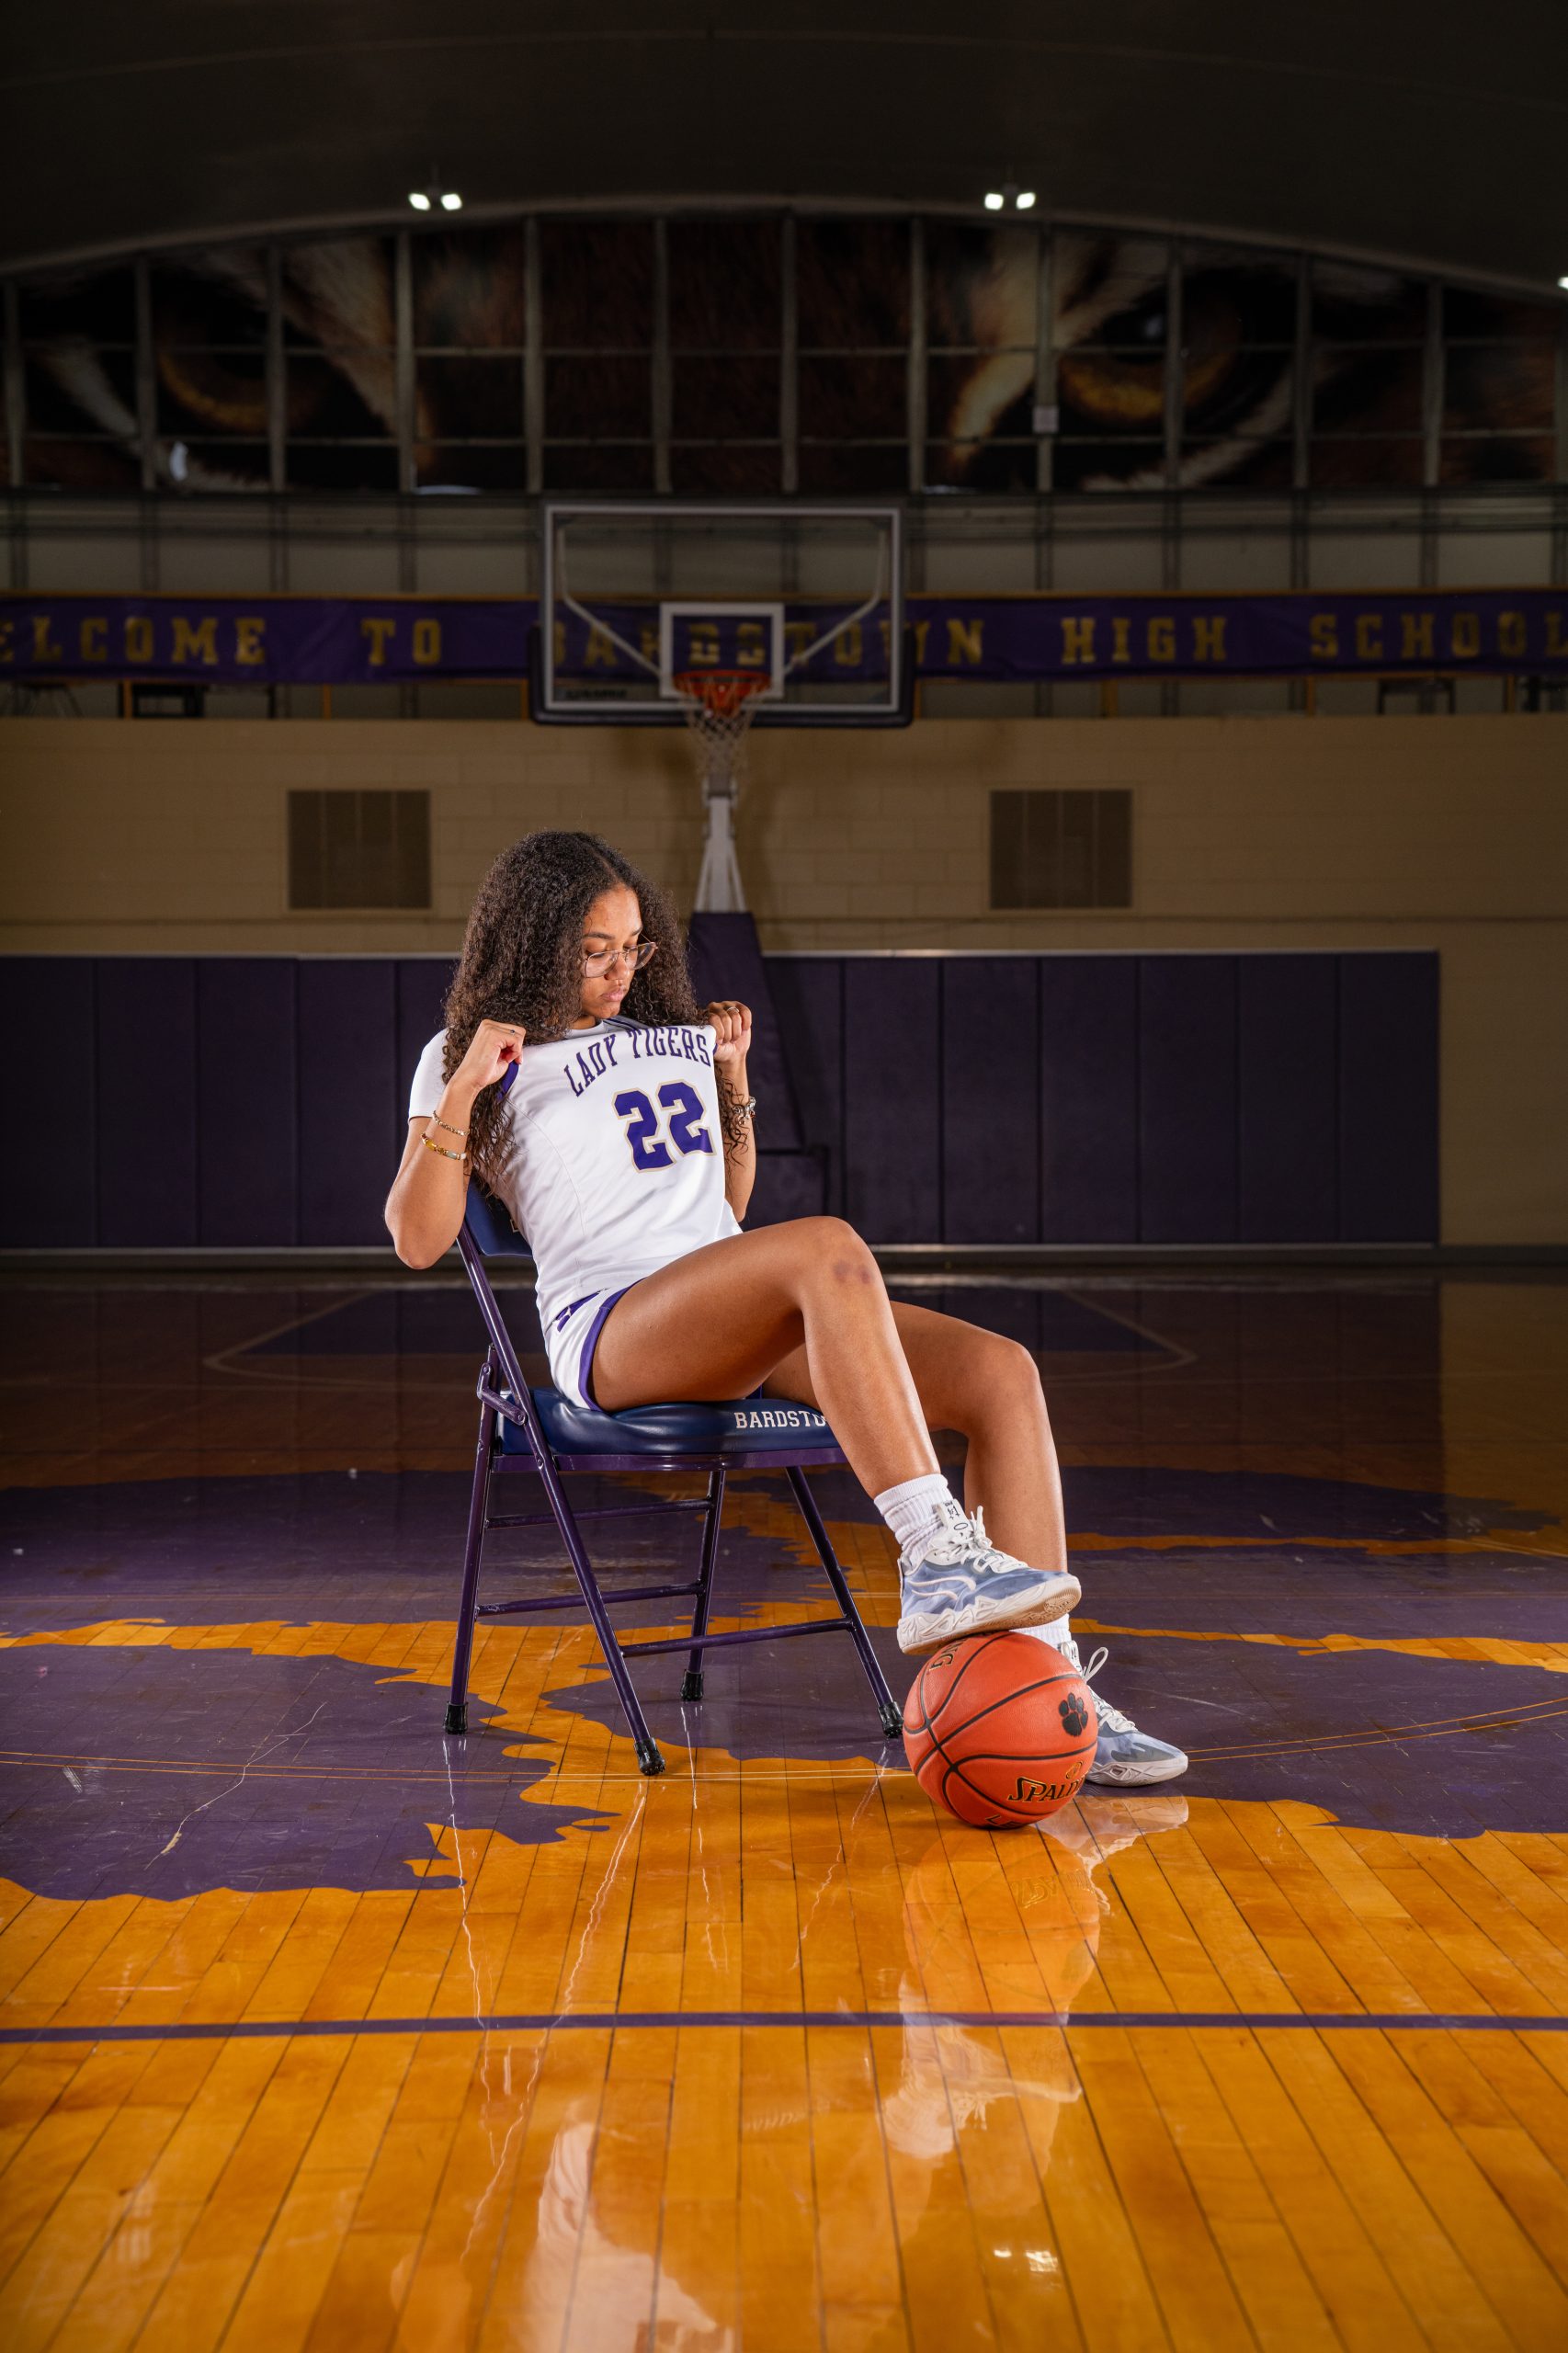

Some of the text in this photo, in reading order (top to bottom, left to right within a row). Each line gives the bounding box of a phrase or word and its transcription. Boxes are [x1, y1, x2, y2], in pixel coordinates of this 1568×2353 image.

[360, 618, 441, 666] TO
[1061, 616, 1227, 665] HIGH
[1309, 610, 1568, 660] SCHOOL
[563, 1026, 711, 1097] LADY TIGERS
[611, 1078, 717, 1174] 22
